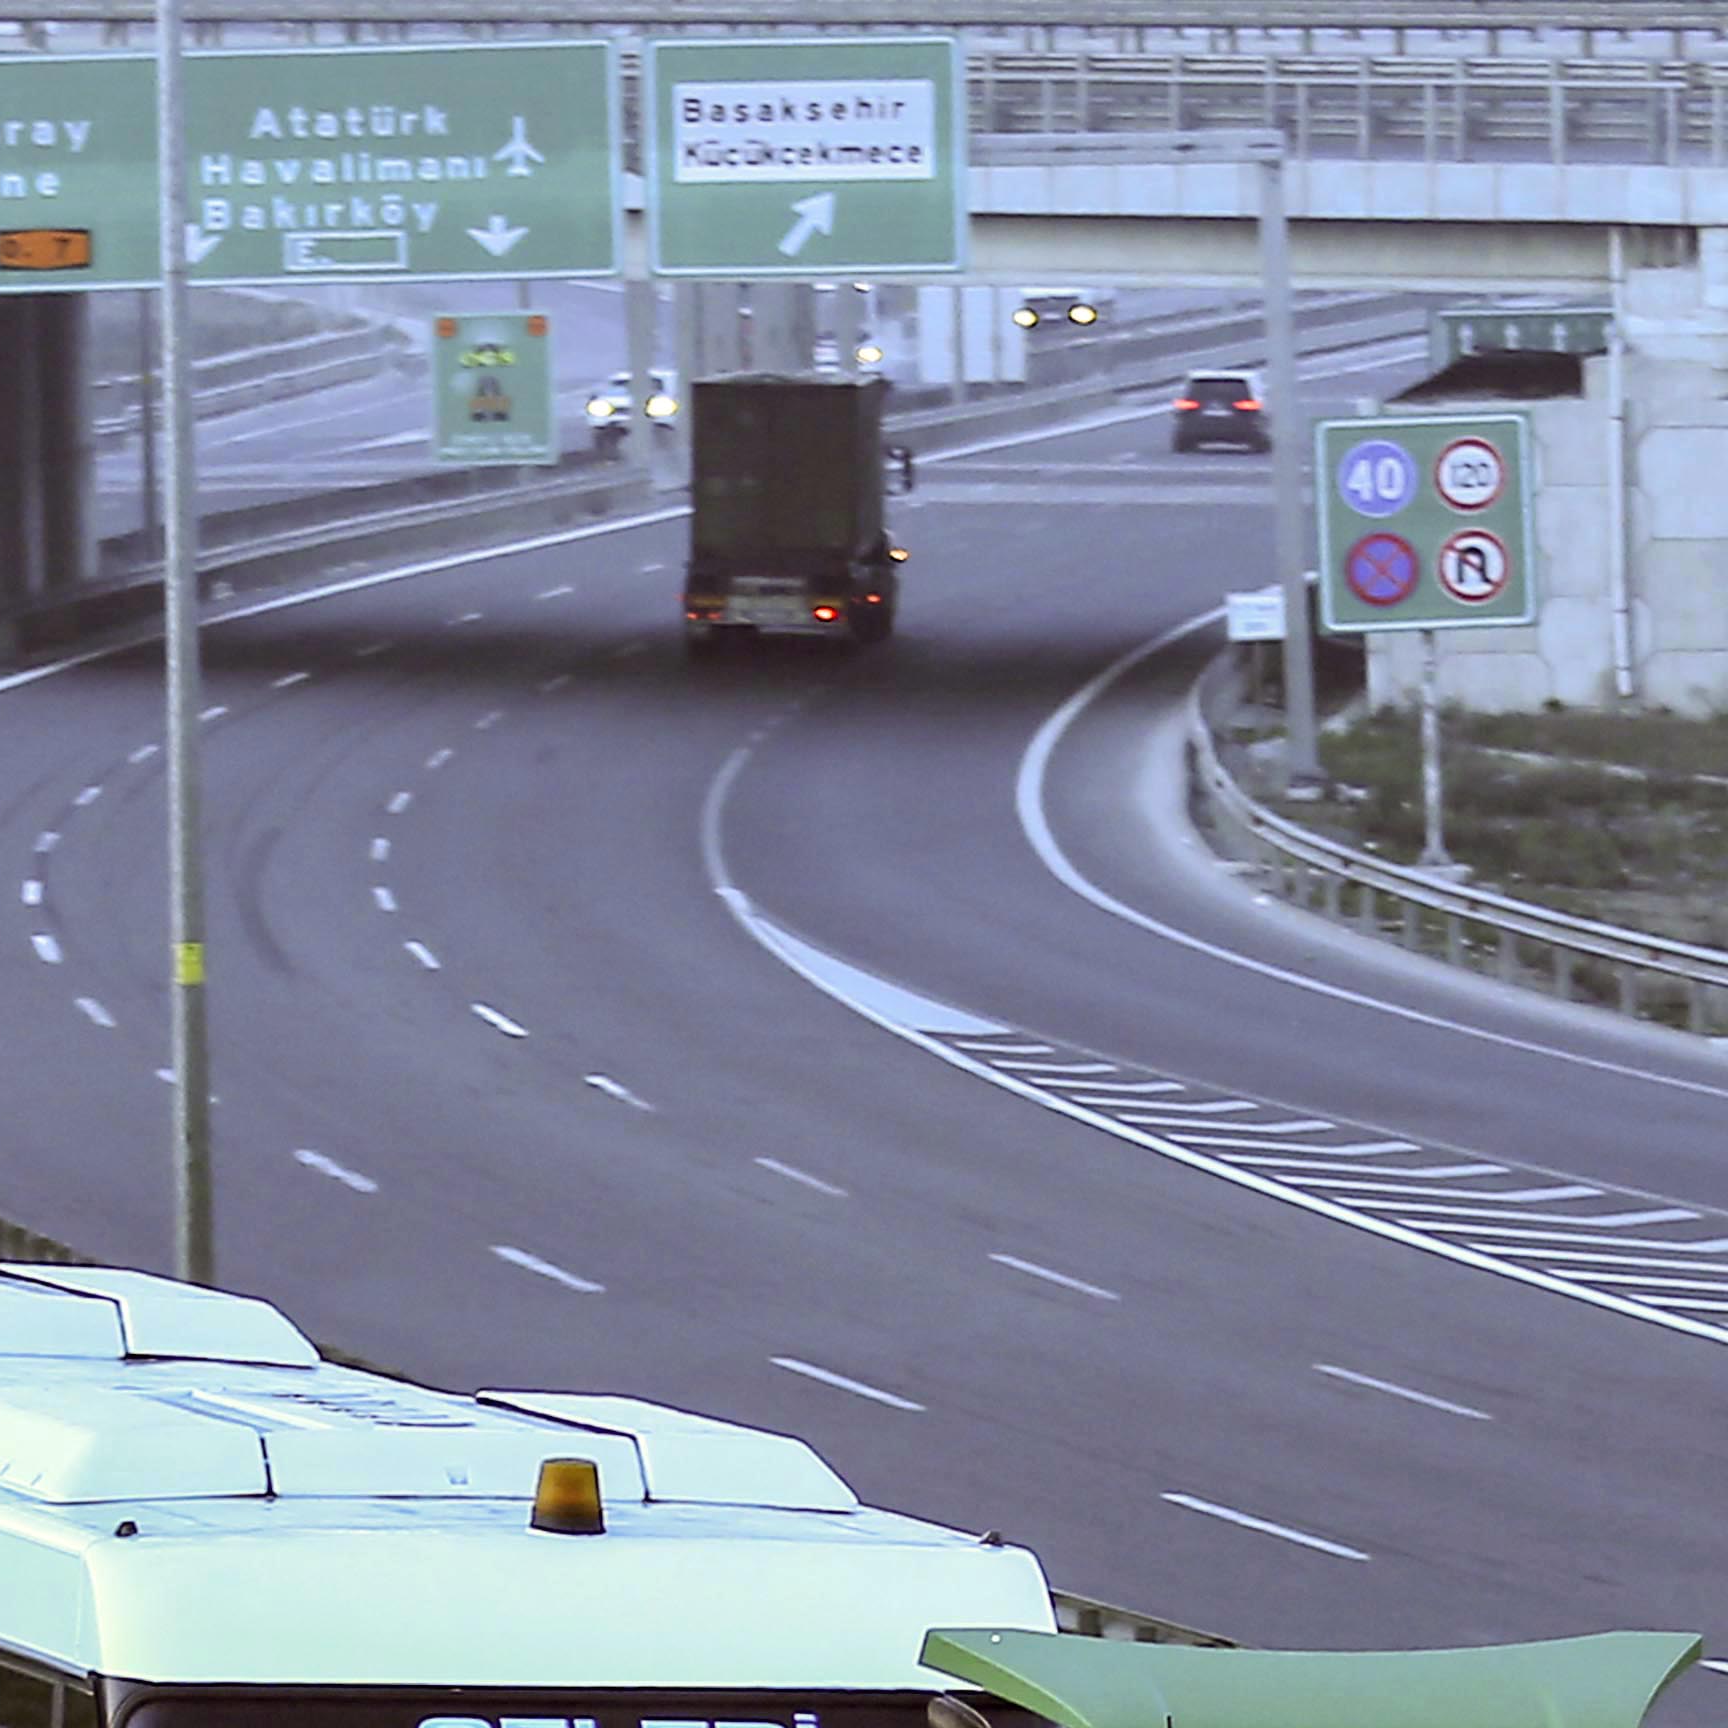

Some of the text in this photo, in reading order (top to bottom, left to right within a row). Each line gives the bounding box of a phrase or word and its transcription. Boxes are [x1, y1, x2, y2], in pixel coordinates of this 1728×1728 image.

[248, 105, 449, 139] Atatürk
[201, 193, 439, 232] Bakırköy
[1347, 456, 1406, 501] 40
